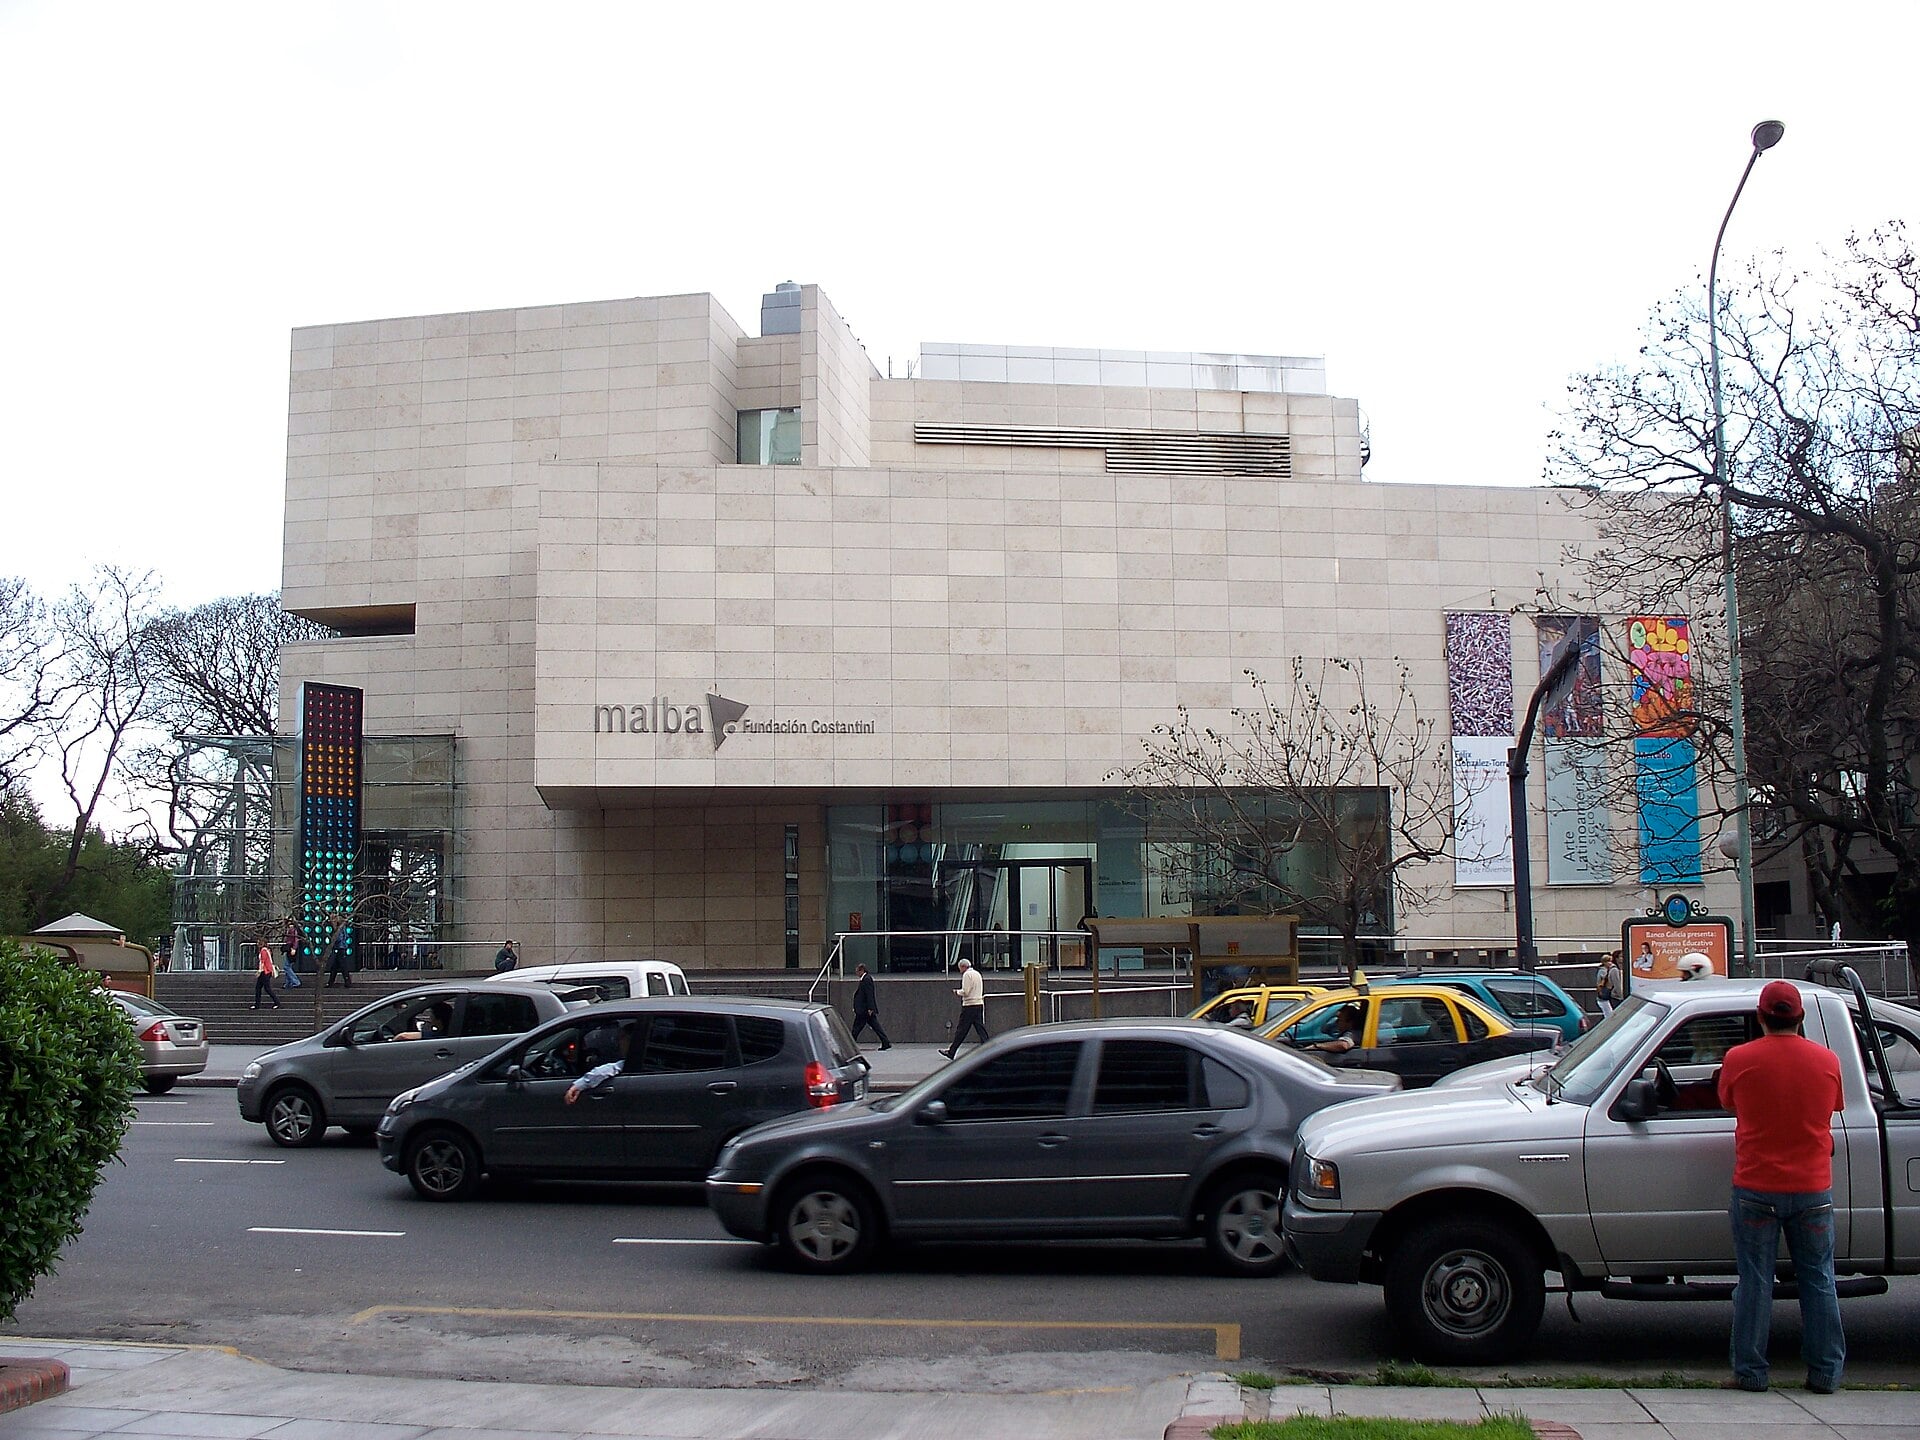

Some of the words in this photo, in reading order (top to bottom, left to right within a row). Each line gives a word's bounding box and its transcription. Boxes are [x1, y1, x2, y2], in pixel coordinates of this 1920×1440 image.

[595, 696, 703, 733] malba
[743, 719, 806, 734] Fundación
[811, 719, 875, 734] Costantini
[1588, 811, 1596, 845] SIGLO
[1563, 831, 1575, 862] Arte
